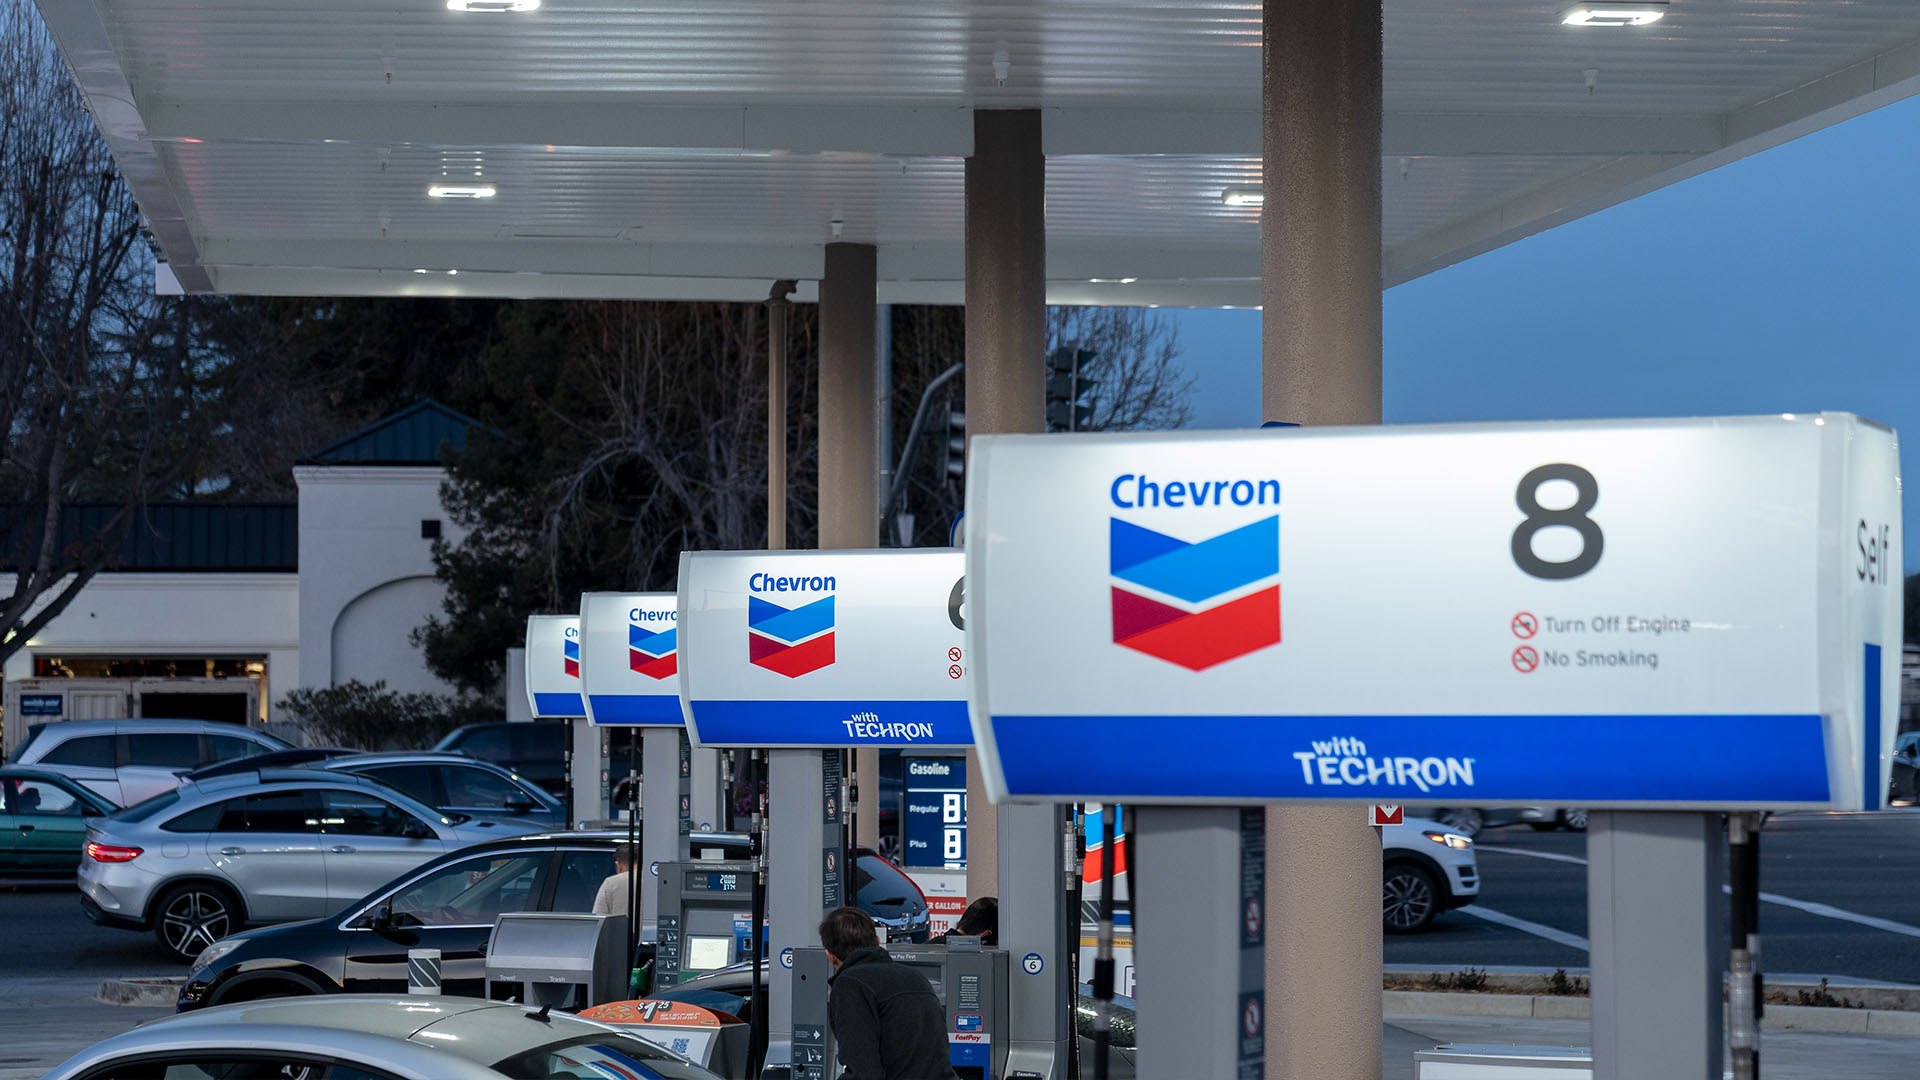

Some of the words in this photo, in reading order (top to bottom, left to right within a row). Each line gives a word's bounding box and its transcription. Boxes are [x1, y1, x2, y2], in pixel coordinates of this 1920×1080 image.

[1110, 474, 1280, 509] Chevron
[1511, 463, 1604, 580] 8
[1856, 518, 1888, 586] Self
[749, 572, 836, 592] Chevron
[629, 608, 677, 622] Chevro
[1544, 616, 1586, 633] Turn
[1591, 615, 1620, 633] Off
[1627, 615, 1691, 636] Engine
[1543, 650, 1570, 667] No
[1575, 649, 1659, 670] Smoking
[851, 712, 879, 722] with
[842, 720, 934, 741] TECHRON
[1312, 736, 1366, 756] with
[909, 763, 950, 775] Gasoline
[1293, 752, 1475, 793] TECHRON
[909, 805, 939, 814] Regular
[943, 794, 967, 823] 8
[909, 840, 928, 848] Plus
[935, 902, 961, 910] GALLON
[785, 955, 792, 964] 6
[1029, 961, 1037, 970] 6
[955, 1034, 981, 1042] FastPay
